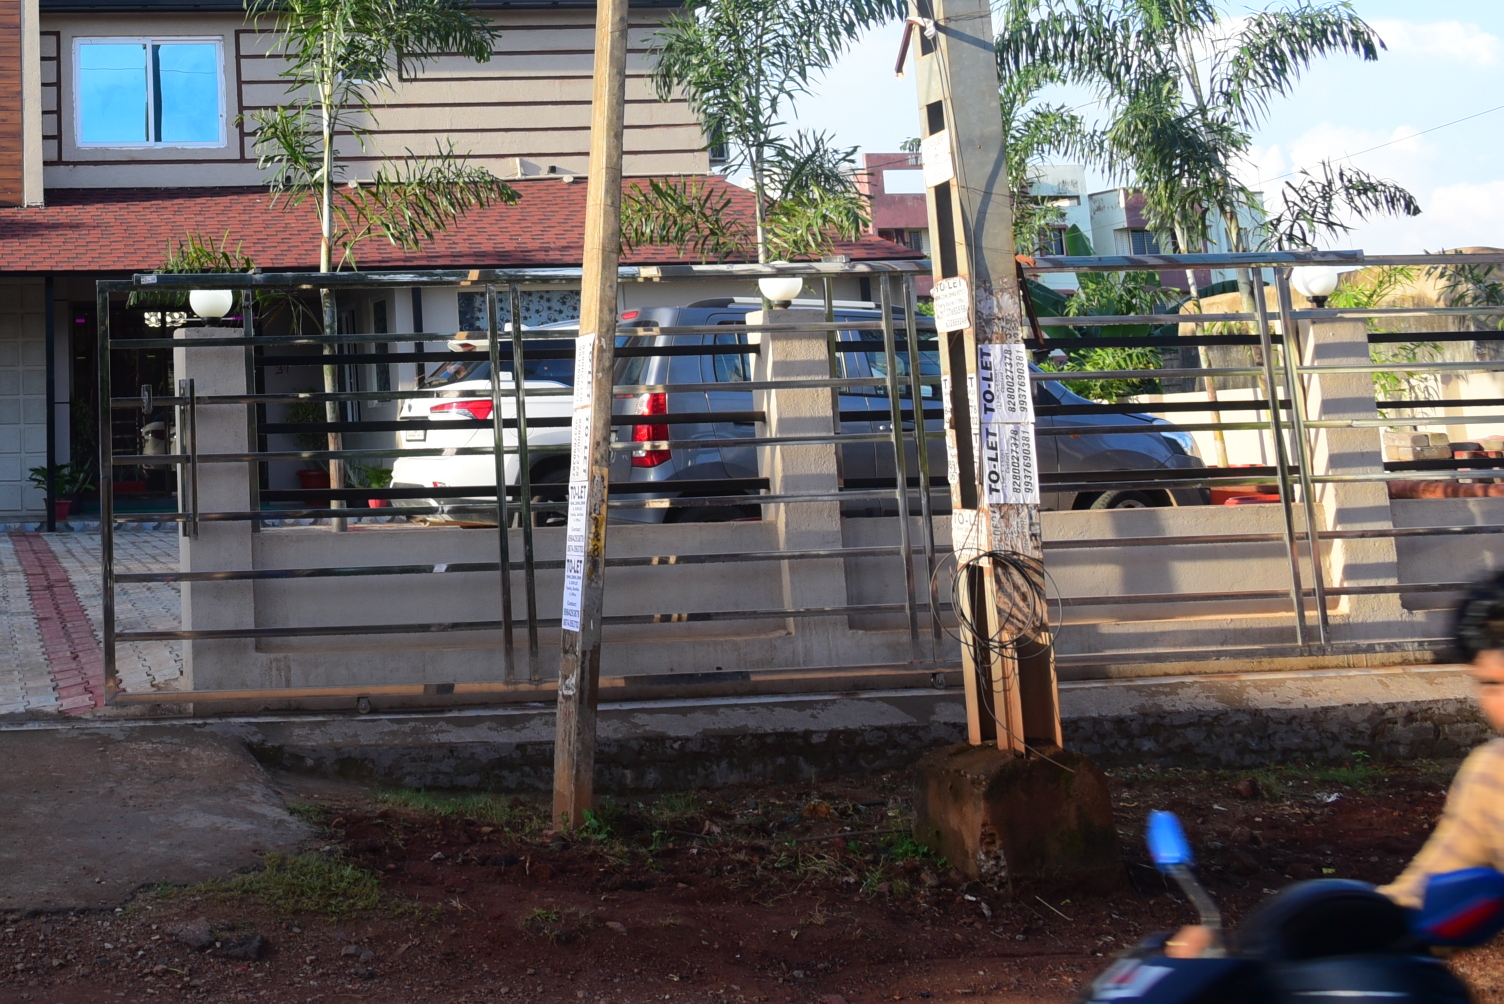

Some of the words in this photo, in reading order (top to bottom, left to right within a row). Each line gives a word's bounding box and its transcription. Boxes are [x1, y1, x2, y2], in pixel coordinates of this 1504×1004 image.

[980, 347, 996, 415] TO-LET
[1004, 349, 1016, 413] 8280027378
[1016, 349, 1028, 413] 9937690381
[570, 485, 587, 500] TO-LET
[985, 427, 1000, 496] TO-LET
[1010, 429, 1021, 494] 8280027378
[1021, 429, 1033, 494] 9937690381
[566, 558, 583, 574] TO-LET
